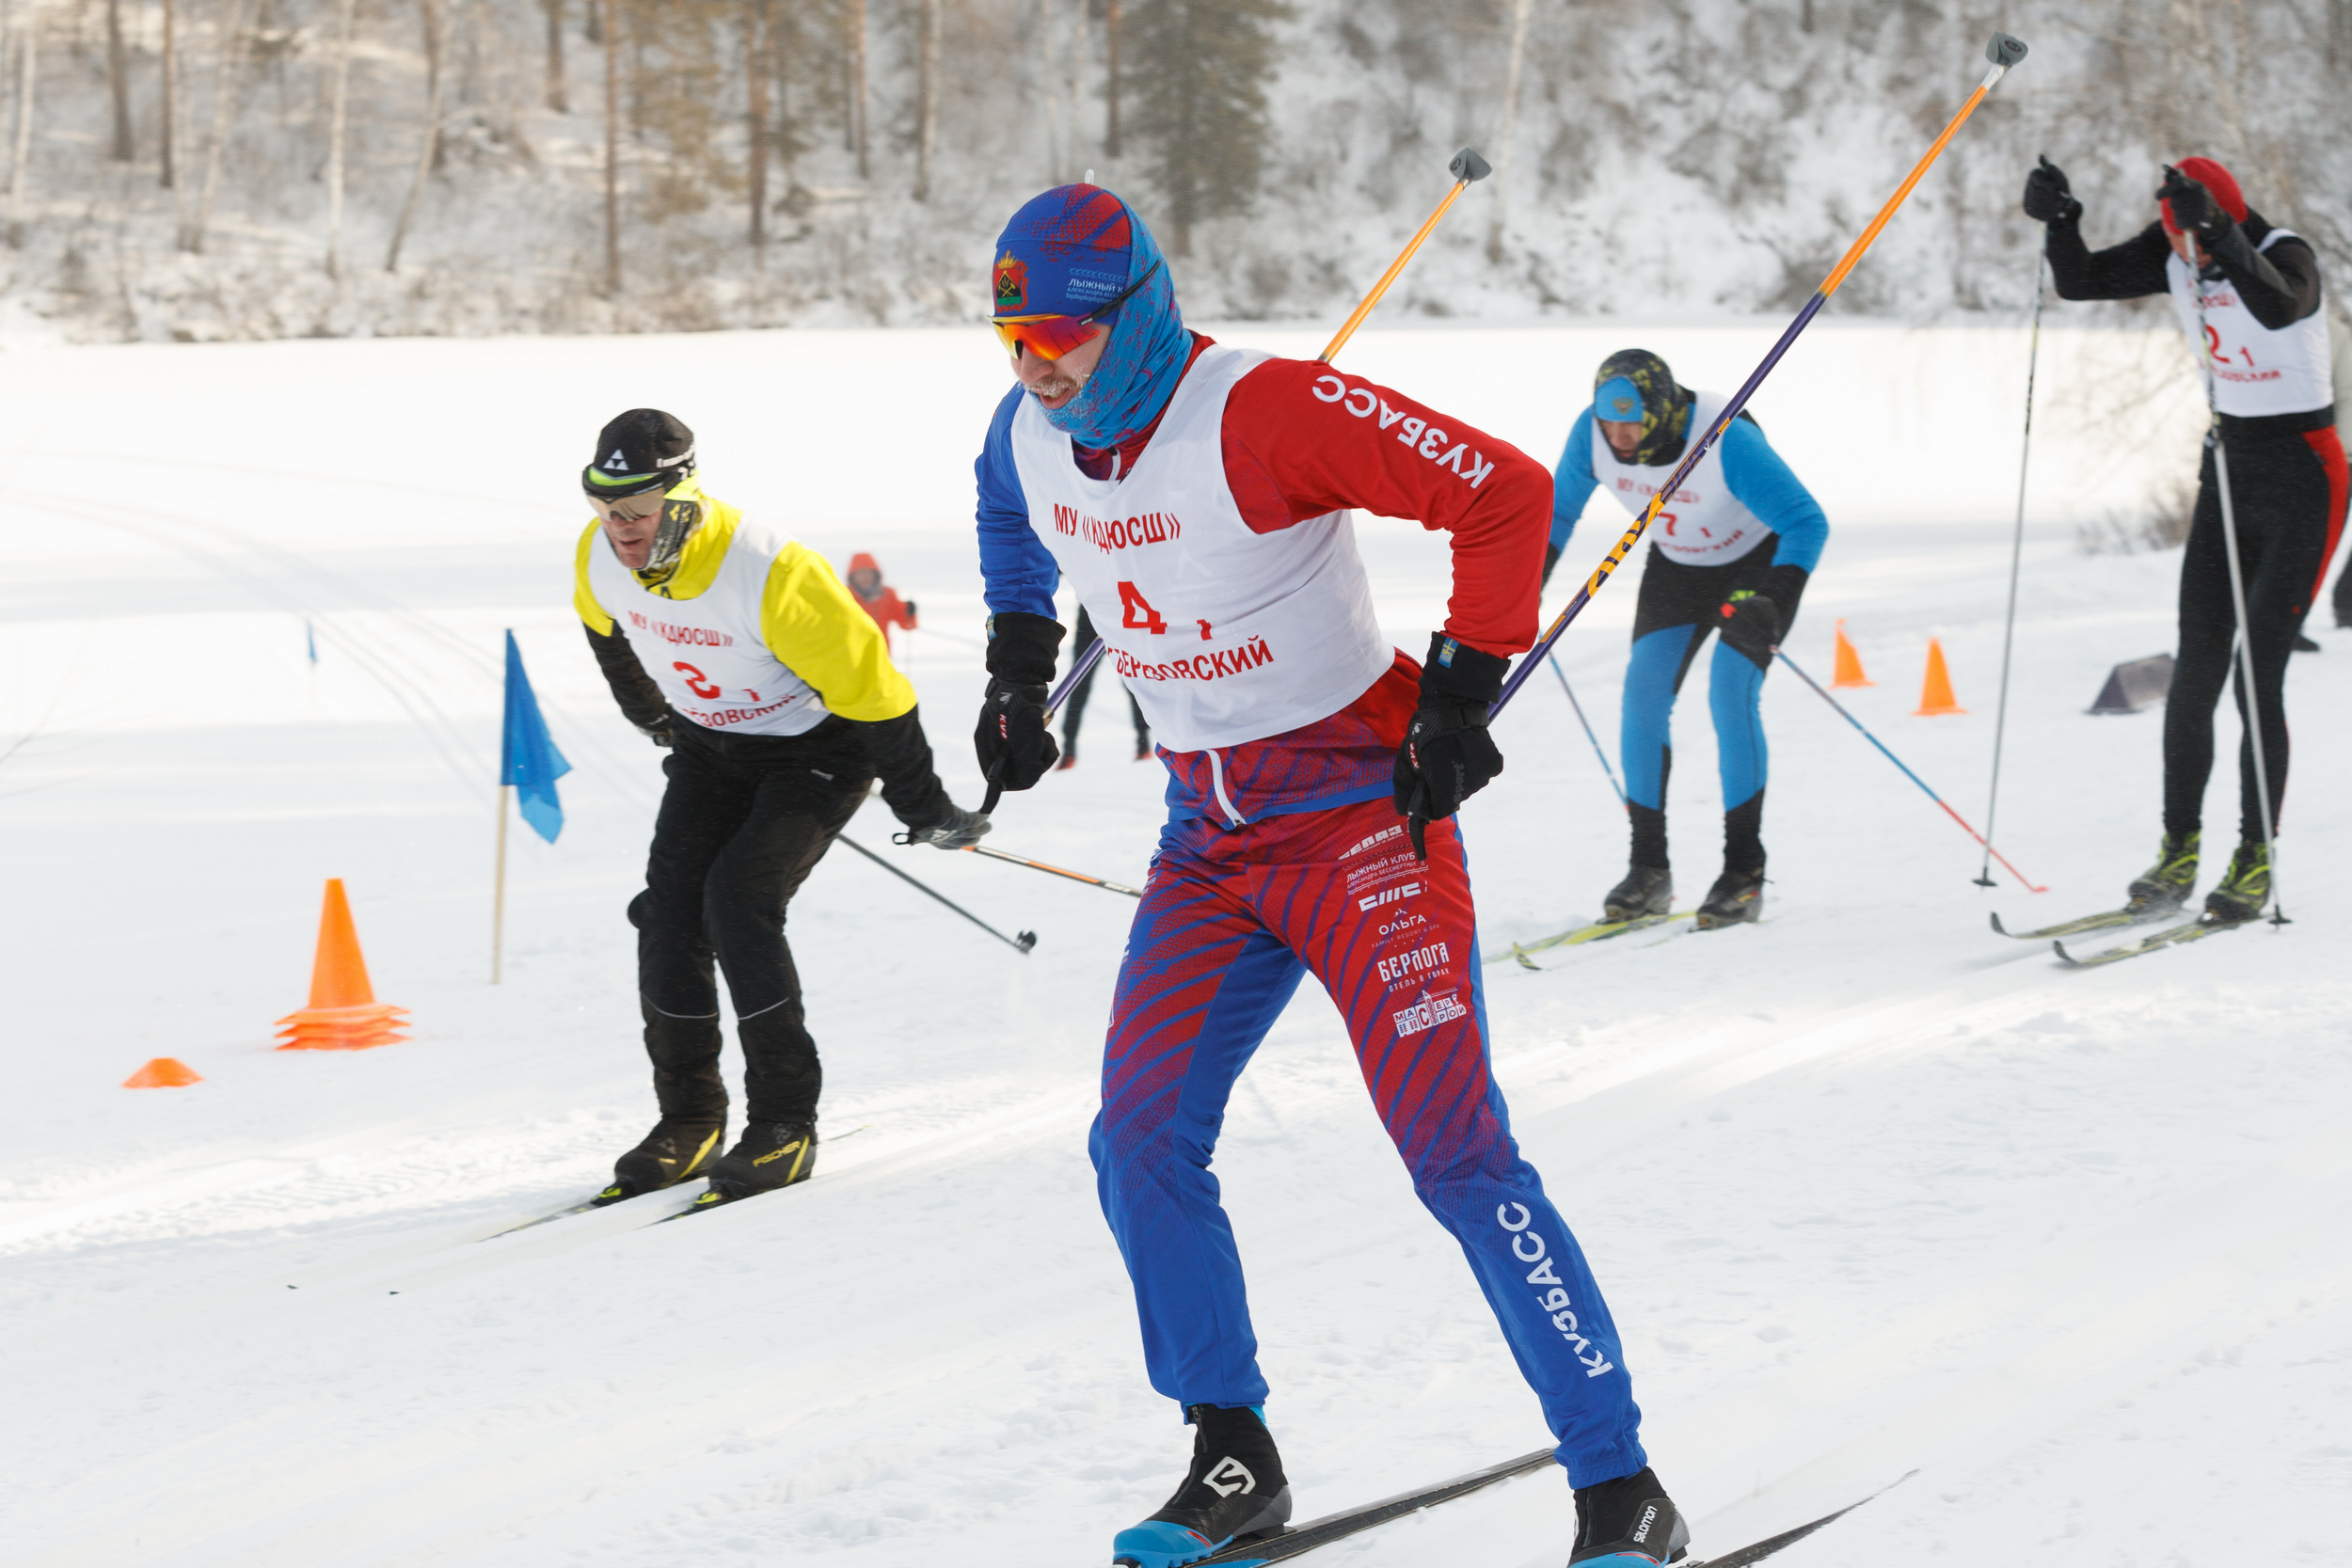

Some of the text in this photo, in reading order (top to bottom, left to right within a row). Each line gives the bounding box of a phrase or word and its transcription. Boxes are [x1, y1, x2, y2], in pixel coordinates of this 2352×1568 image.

[1069, 277, 1116, 293] ЛЫЖНЫЙ
[2240, 345, 2255, 367] 1
[1311, 374, 1495, 489] КУЗБАСС
[1054, 502, 1078, 537] МУ
[1658, 512, 1678, 536] 7
[1197, 619, 1213, 641] 1
[1346, 851, 1416, 883] ЛЫЖНЫЙ КЛУБ
[1346, 872, 1378, 889] АЛЕКСАНДРА
[1378, 913, 1427, 935] ОЛЬГА
[1371, 937, 1394, 948] FAMILY
[1396, 928, 1422, 940] RESORT
[1377, 942, 1450, 983] БЕРЛОГА
[1388, 978, 1416, 992] ОТЕЛЬ
[1427, 967, 1450, 979] ГОРАХ
[753, 1141, 802, 1167] FISCHER
[1496, 1201, 1614, 1379] КУЗБАСС
[1632, 1505, 1658, 1544] salomon
